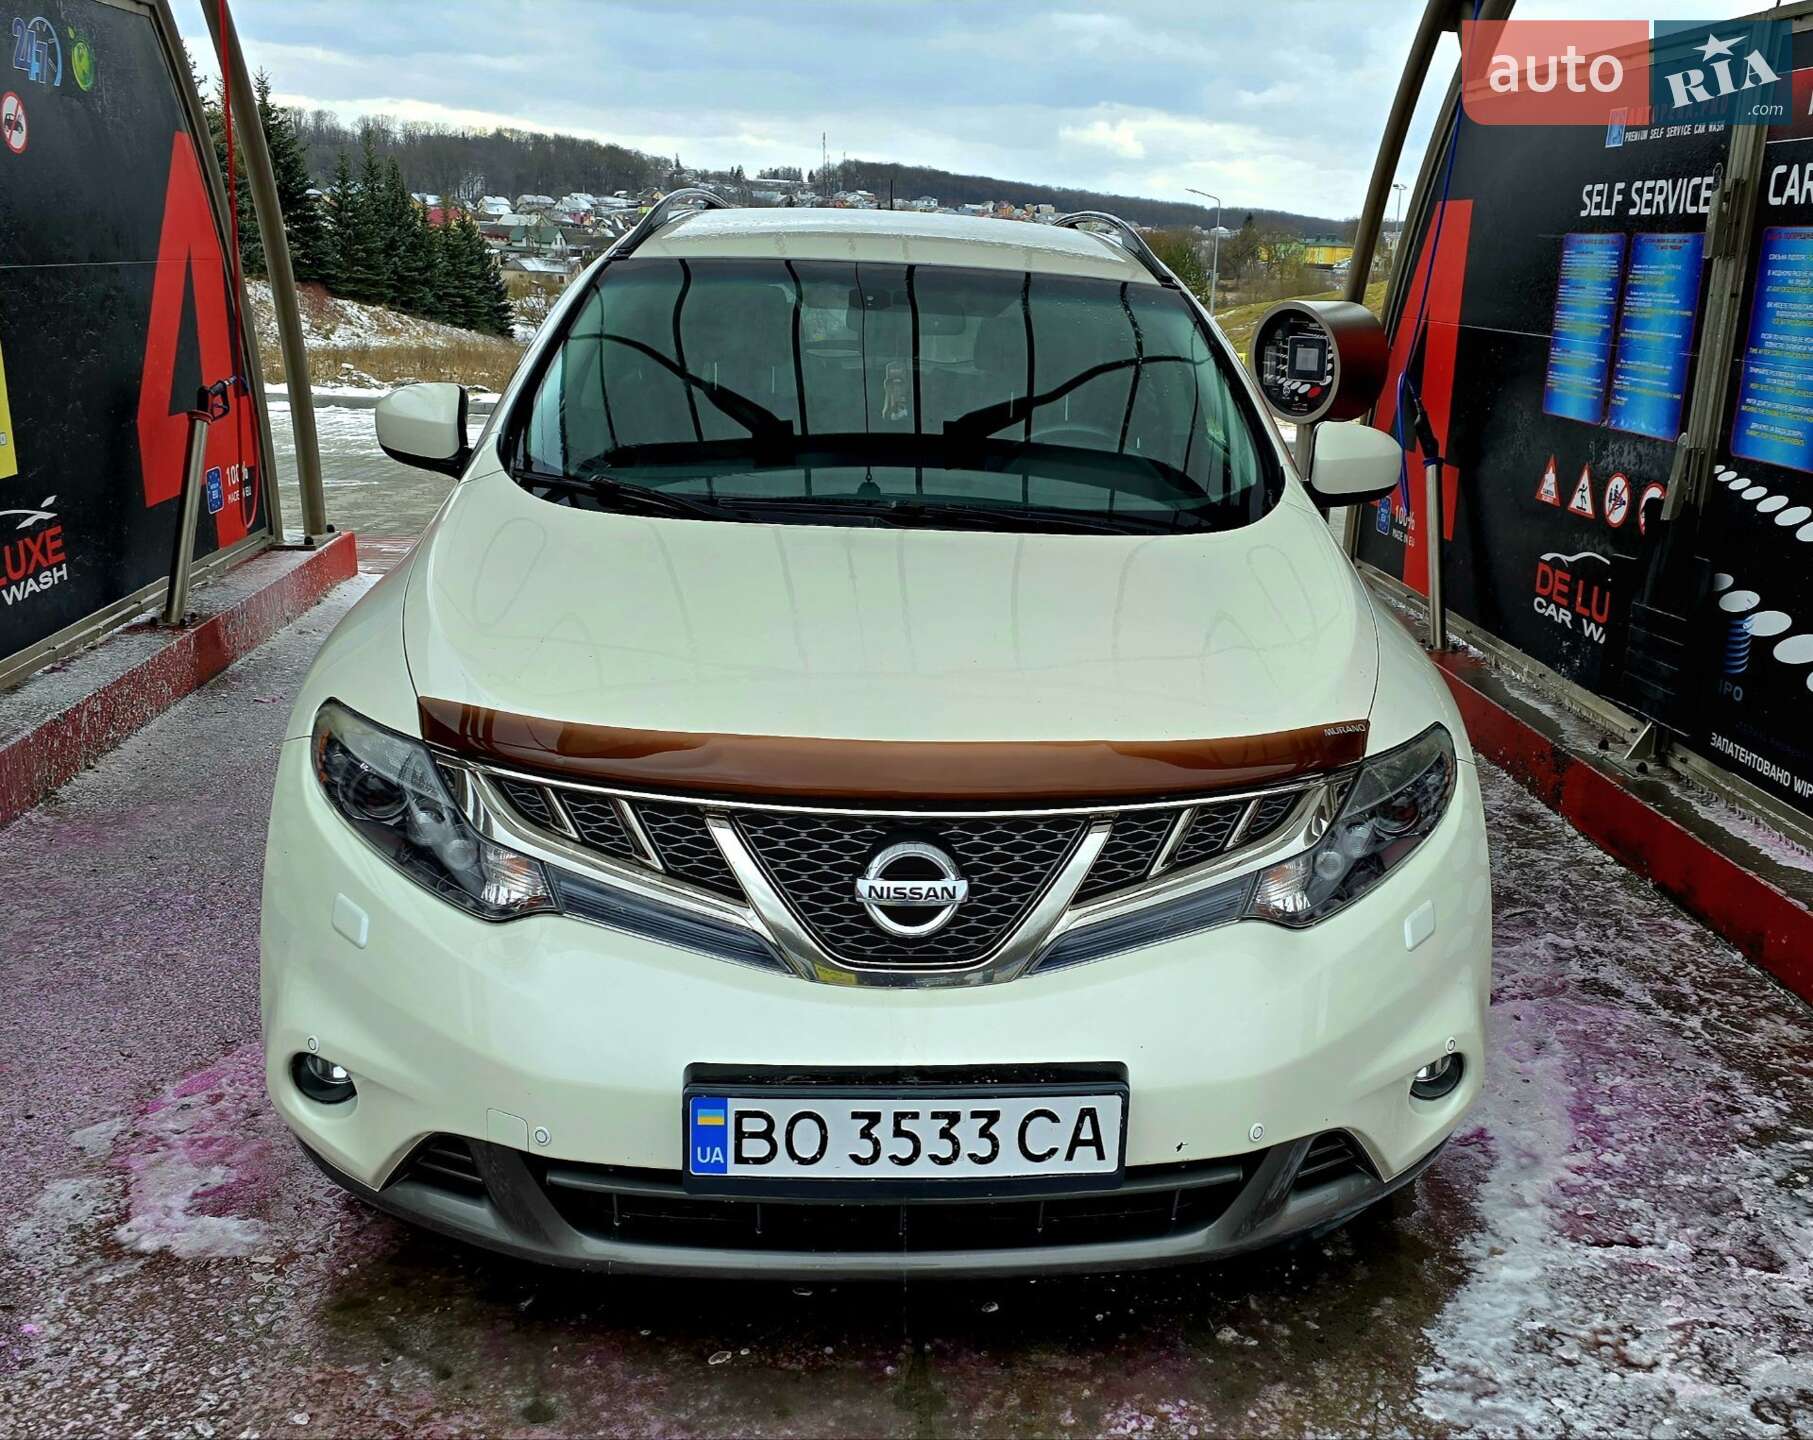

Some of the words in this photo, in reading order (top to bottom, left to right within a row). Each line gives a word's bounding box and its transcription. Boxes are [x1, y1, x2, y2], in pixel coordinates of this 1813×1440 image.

[1624, 129, 1649, 142] PREMIUM
[1649, 126, 1665, 140] SELF
[1666, 124, 1692, 138] SERVICE
[1580, 182, 1625, 217] SELF
[1628, 176, 1714, 215] SERVICE
[1767, 161, 1813, 206] CAR
[1, 563, 68, 606] WASH
[1535, 562, 1571, 608] DE
[1533, 596, 1573, 630] CAR
[1323, 723, 1366, 736] MURANO
[1710, 731, 1791, 788] ЗАПАТЕНТОВАНО
[868, 885, 957, 900] NISSAN
[697, 1147, 724, 1164] UA
[733, 1109, 829, 1166] BO
[847, 1109, 1001, 1167] 3533
[1017, 1106, 1107, 1163] CA
